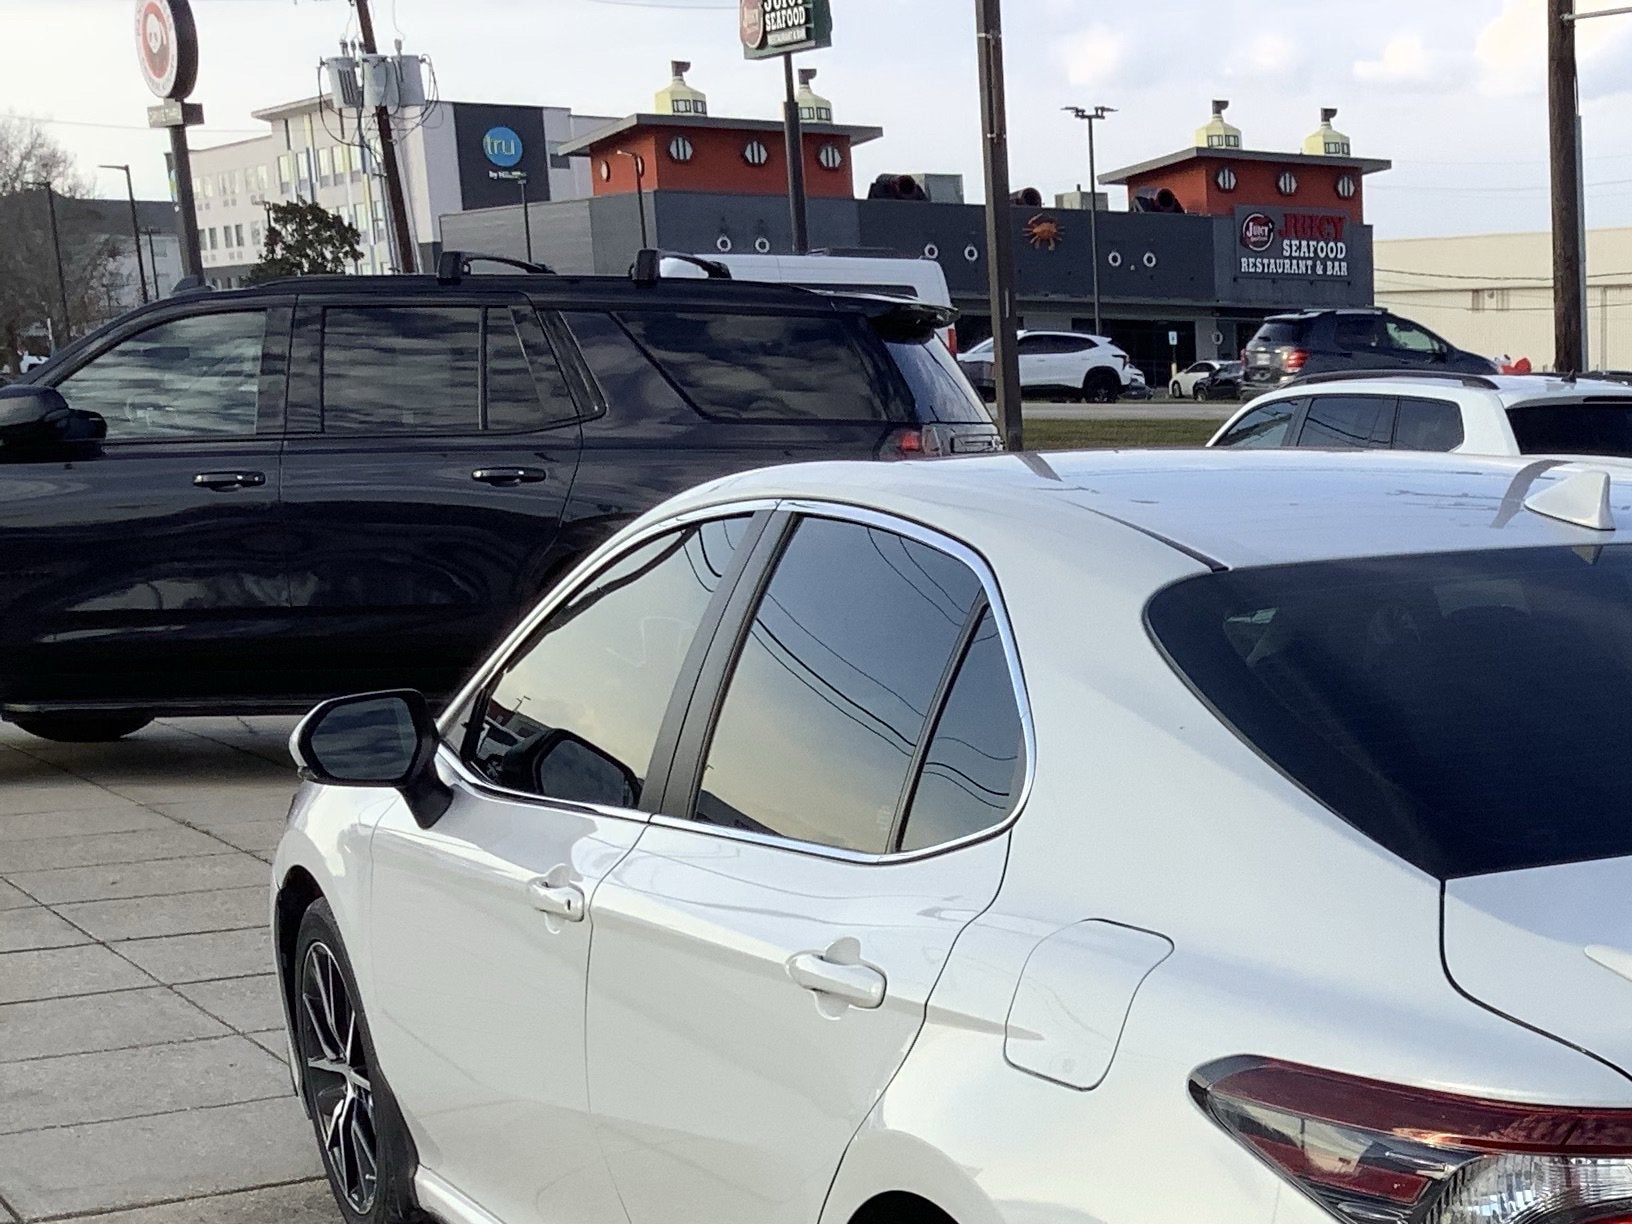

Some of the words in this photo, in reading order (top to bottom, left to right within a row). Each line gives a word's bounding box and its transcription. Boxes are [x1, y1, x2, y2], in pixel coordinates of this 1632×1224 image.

[765, 6, 806, 31] SEAFOOD
[486, 134, 515, 155] tru
[1278, 213, 1346, 240] JUICY
[1282, 239, 1347, 259] SEAFOOD
[1240, 257, 1313, 275] RESTAURANT
[1315, 260, 1324, 275] &
[1326, 261, 1349, 276] BAR
